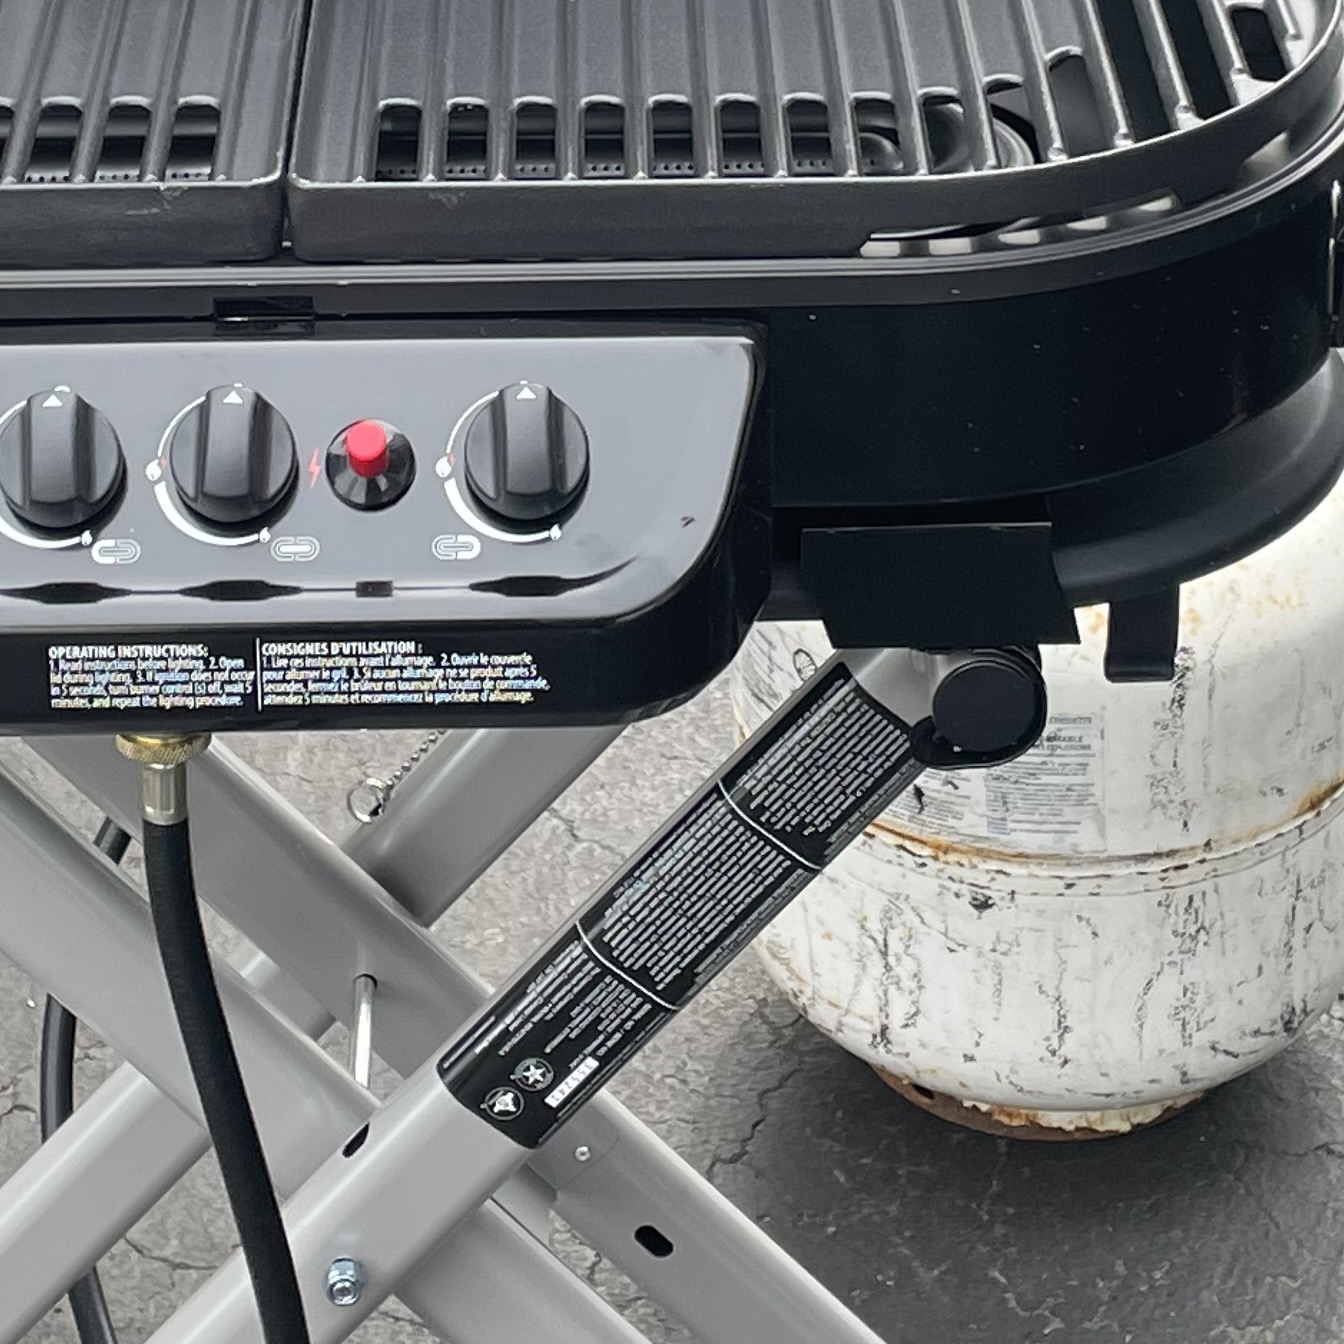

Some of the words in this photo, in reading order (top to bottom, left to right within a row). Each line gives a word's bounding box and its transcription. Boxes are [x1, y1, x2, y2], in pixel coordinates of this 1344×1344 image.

[49, 645, 116, 659] OPERATING
[117, 644, 209, 659] INSTRUCTIONS:
[262, 642, 328, 655] CONSIGNES
[330, 641, 415, 655] D'UTILISATION
[59, 659, 82, 671] Read
[84, 658, 136, 670] instructions
[137, 658, 167, 670] before
[168, 657, 205, 672] lighting.
[219, 656, 244, 671] Open
[271, 656, 288, 668] Lire
[305, 655, 357, 667] instructions
[451, 653, 479, 666] Ouvrir
[490, 652, 533, 665] couvercle
[63, 671, 94, 685] during
[95, 671, 132, 685] lighting.
[154, 670, 189, 684] ignition
[191, 670, 212, 681] does
[213, 670, 229, 681] not
[230, 670, 255, 681] occur
[263, 669, 284, 682] pour
[285, 668, 320, 679] allumer
[373, 668, 401, 678] aucun
[402, 667, 444, 680] allumage
[446, 668, 457, 677] ne
[458, 668, 469, 677] se
[470, 666, 503, 679] produit
[108, 684, 128, 695] turn
[130, 683, 160, 694] burner
[161, 681, 193, 693] control
[224, 682, 244, 693] wait
[307, 680, 339, 691] fermez
[384, 681, 396, 690] en
[398, 679, 437, 690] tournant
[448, 678, 481, 689] bouton
[483, 677, 494, 689] de
[92, 696, 110, 707] and
[112, 696, 140, 709] repeat
[141, 695, 157, 707] the
[158, 695, 194, 709] lighting
[196, 694, 243, 709] procedure.
[263, 693, 303, 705] attendez
[311, 692, 349, 703] minutes
[361, 692, 424, 703] recommencez
